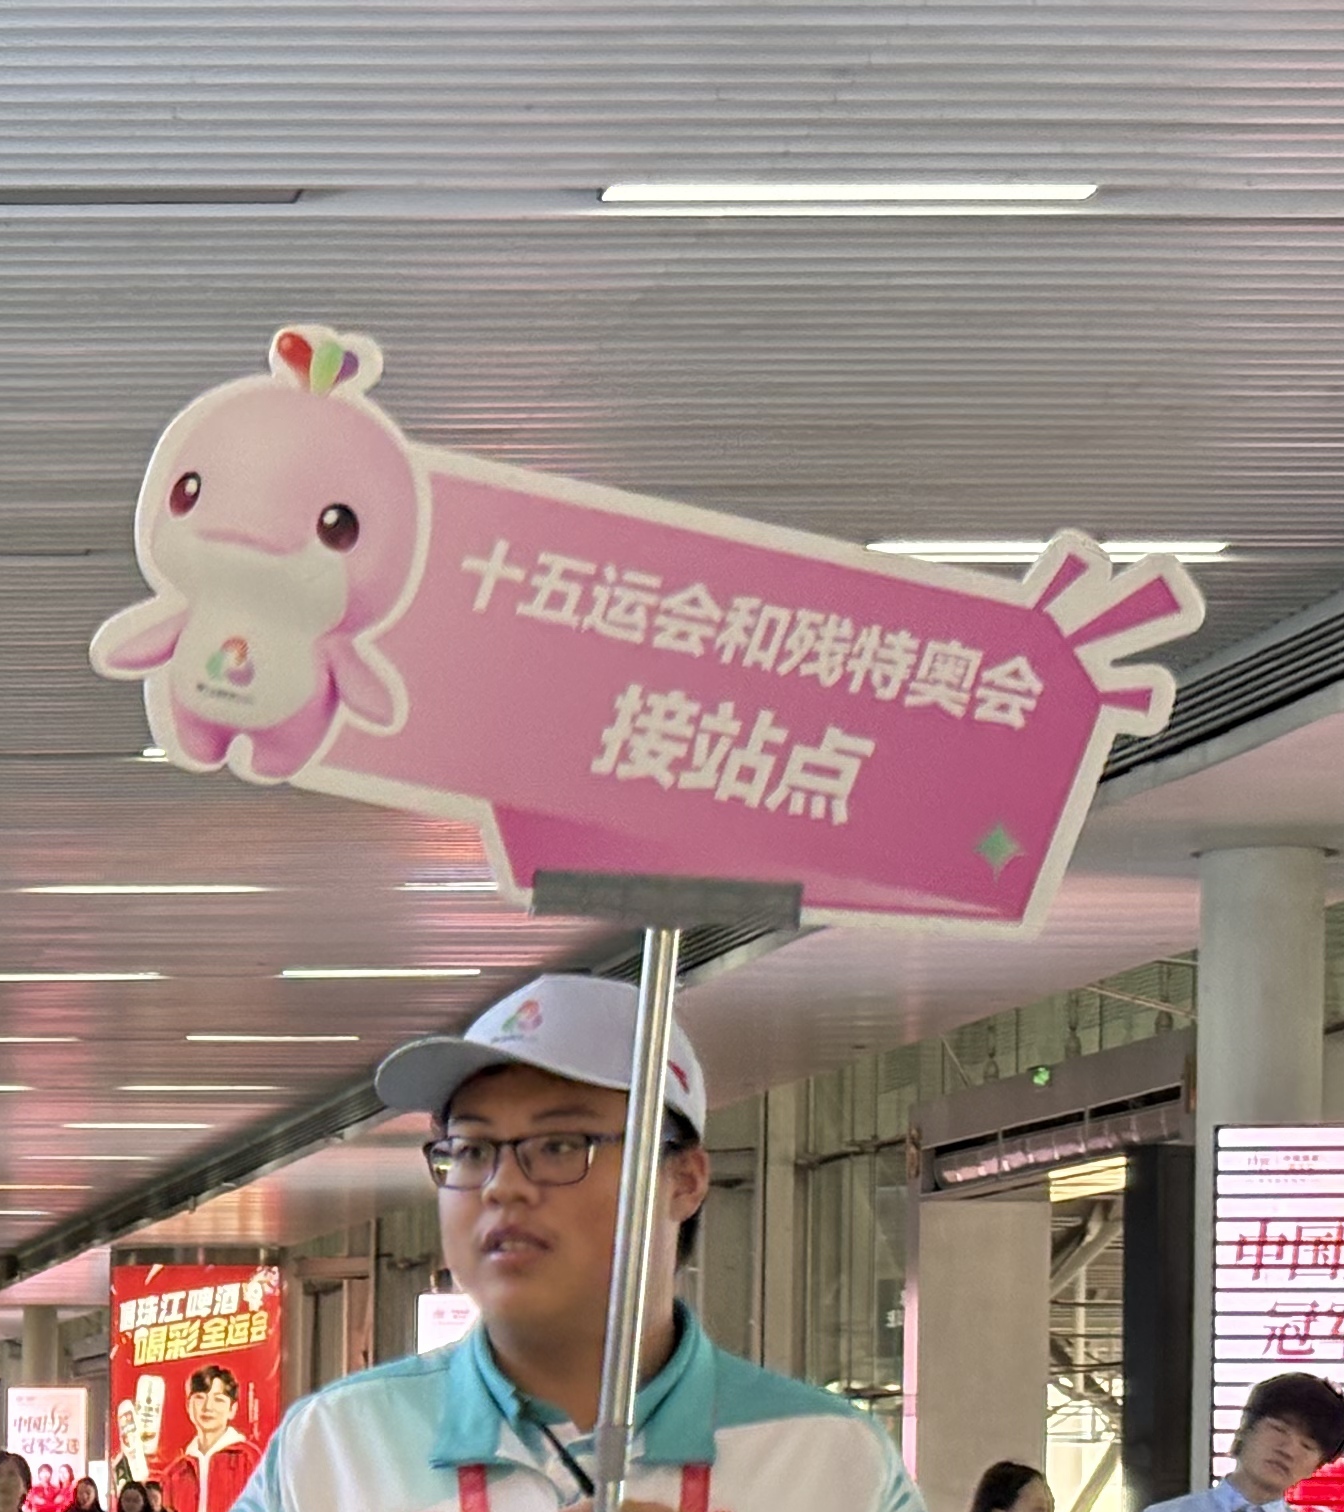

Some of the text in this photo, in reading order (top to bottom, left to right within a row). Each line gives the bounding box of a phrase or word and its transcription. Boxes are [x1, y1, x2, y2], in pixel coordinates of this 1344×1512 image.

[462, 539, 1044, 730] 十五运会和残特奥会
[591, 682, 875, 826] 接站点
[133, 1311, 269, 1366] 喝彩全运会
